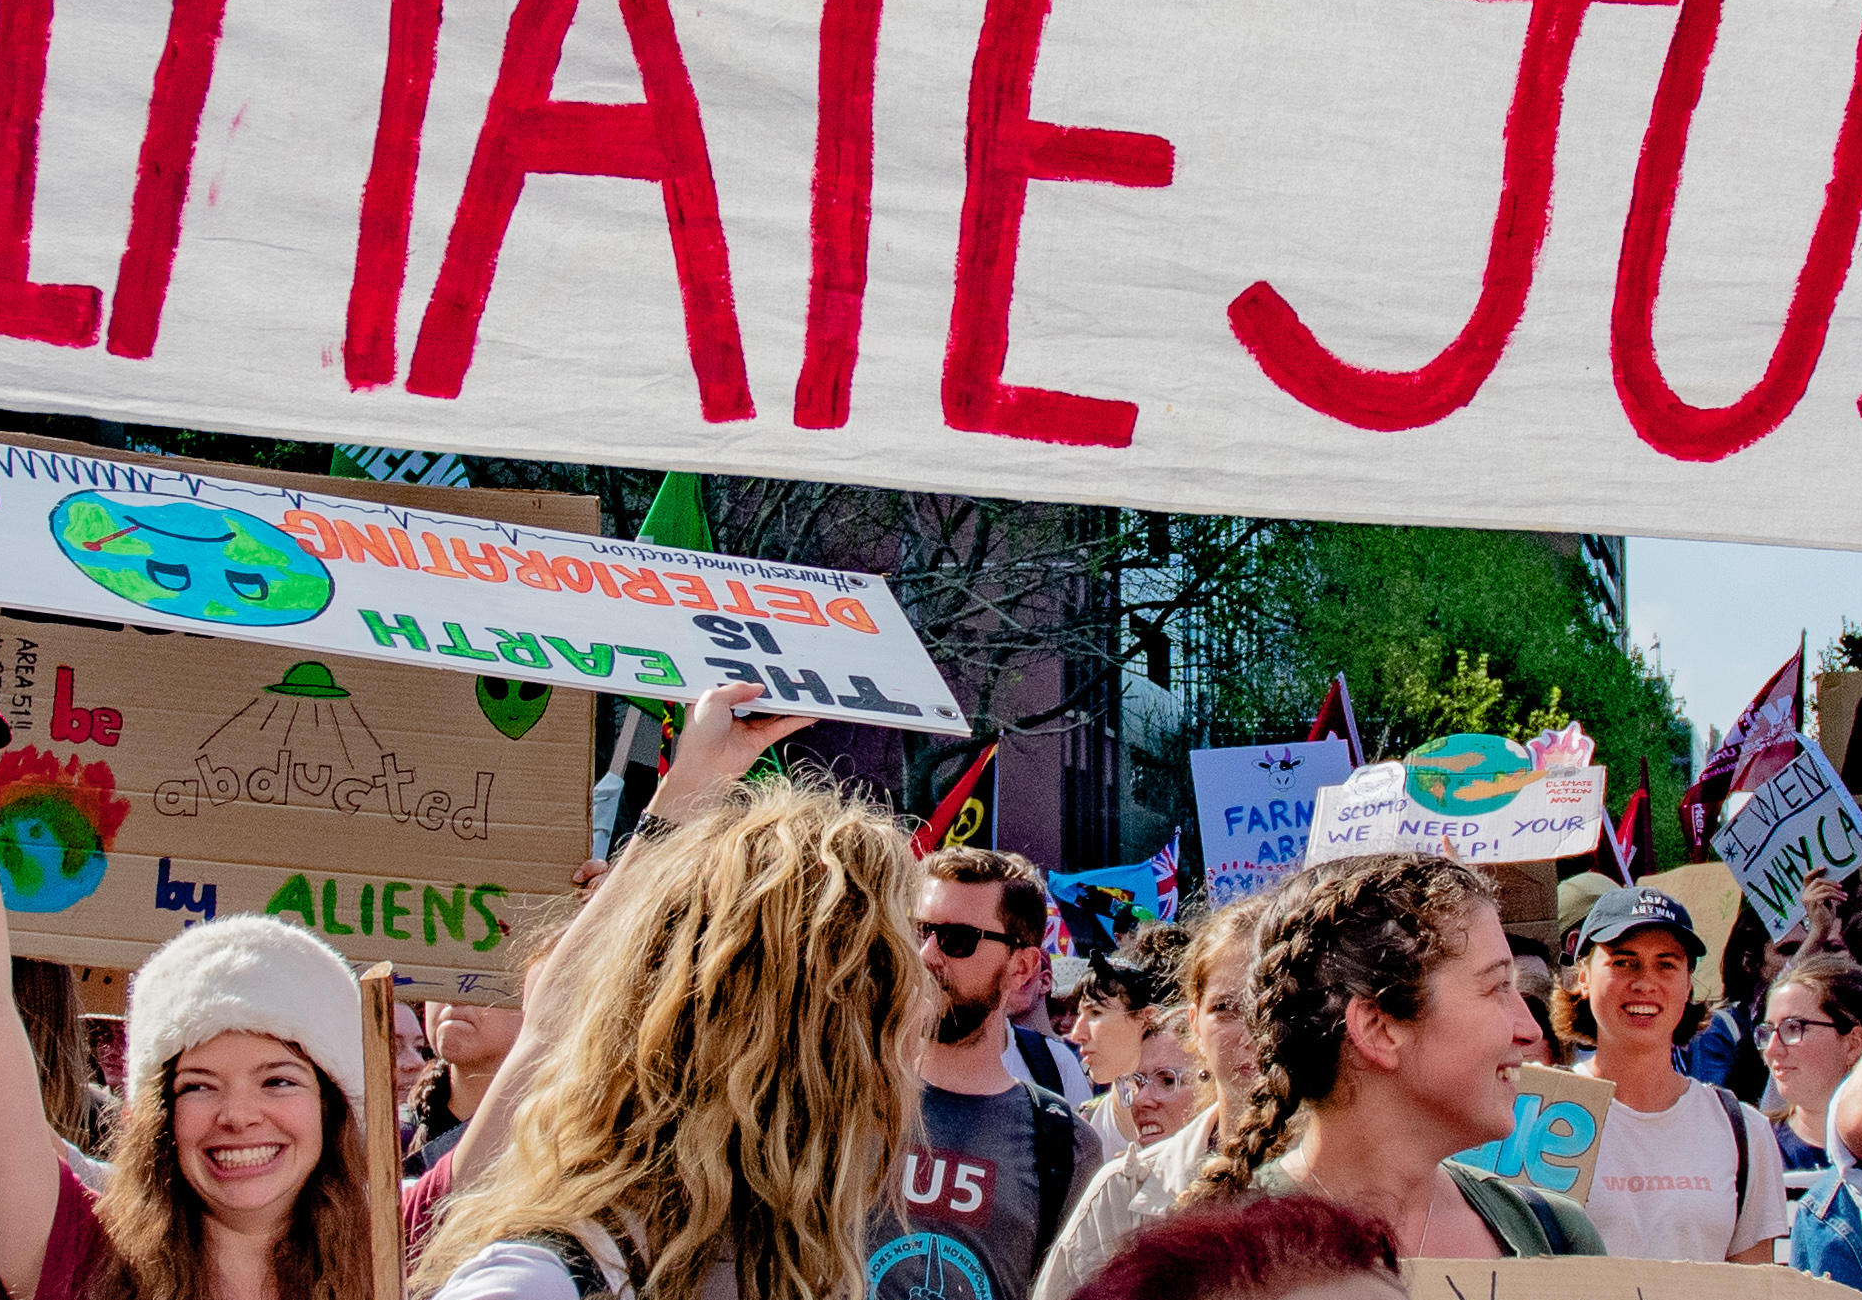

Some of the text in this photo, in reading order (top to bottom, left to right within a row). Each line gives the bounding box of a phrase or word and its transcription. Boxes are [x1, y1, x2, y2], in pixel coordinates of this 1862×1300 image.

[284, 508, 880, 635] DETERIORATING
[693, 613, 784, 655] IS
[14, 637, 40, 688] AREA
[358, 608, 924, 717] THE EARTH
[50, 665, 124, 747] be
[154, 749, 495, 841] abducted
[1545, 780, 1594, 789] CLIMATE
[1546, 788, 1593, 796] ACTION
[1549, 796, 1583, 805] NOW
[1338, 799, 1409, 822] SCOMO
[1328, 815, 1586, 844] WE NEED YOUR
[1746, 835, 1814, 921] WHY
[154, 856, 508, 954] by ALIENS
[1638, 895, 1669, 908] LOVE
[1602, 1174, 1713, 1194] woman
[870, 1251, 893, 1279] JOBS
